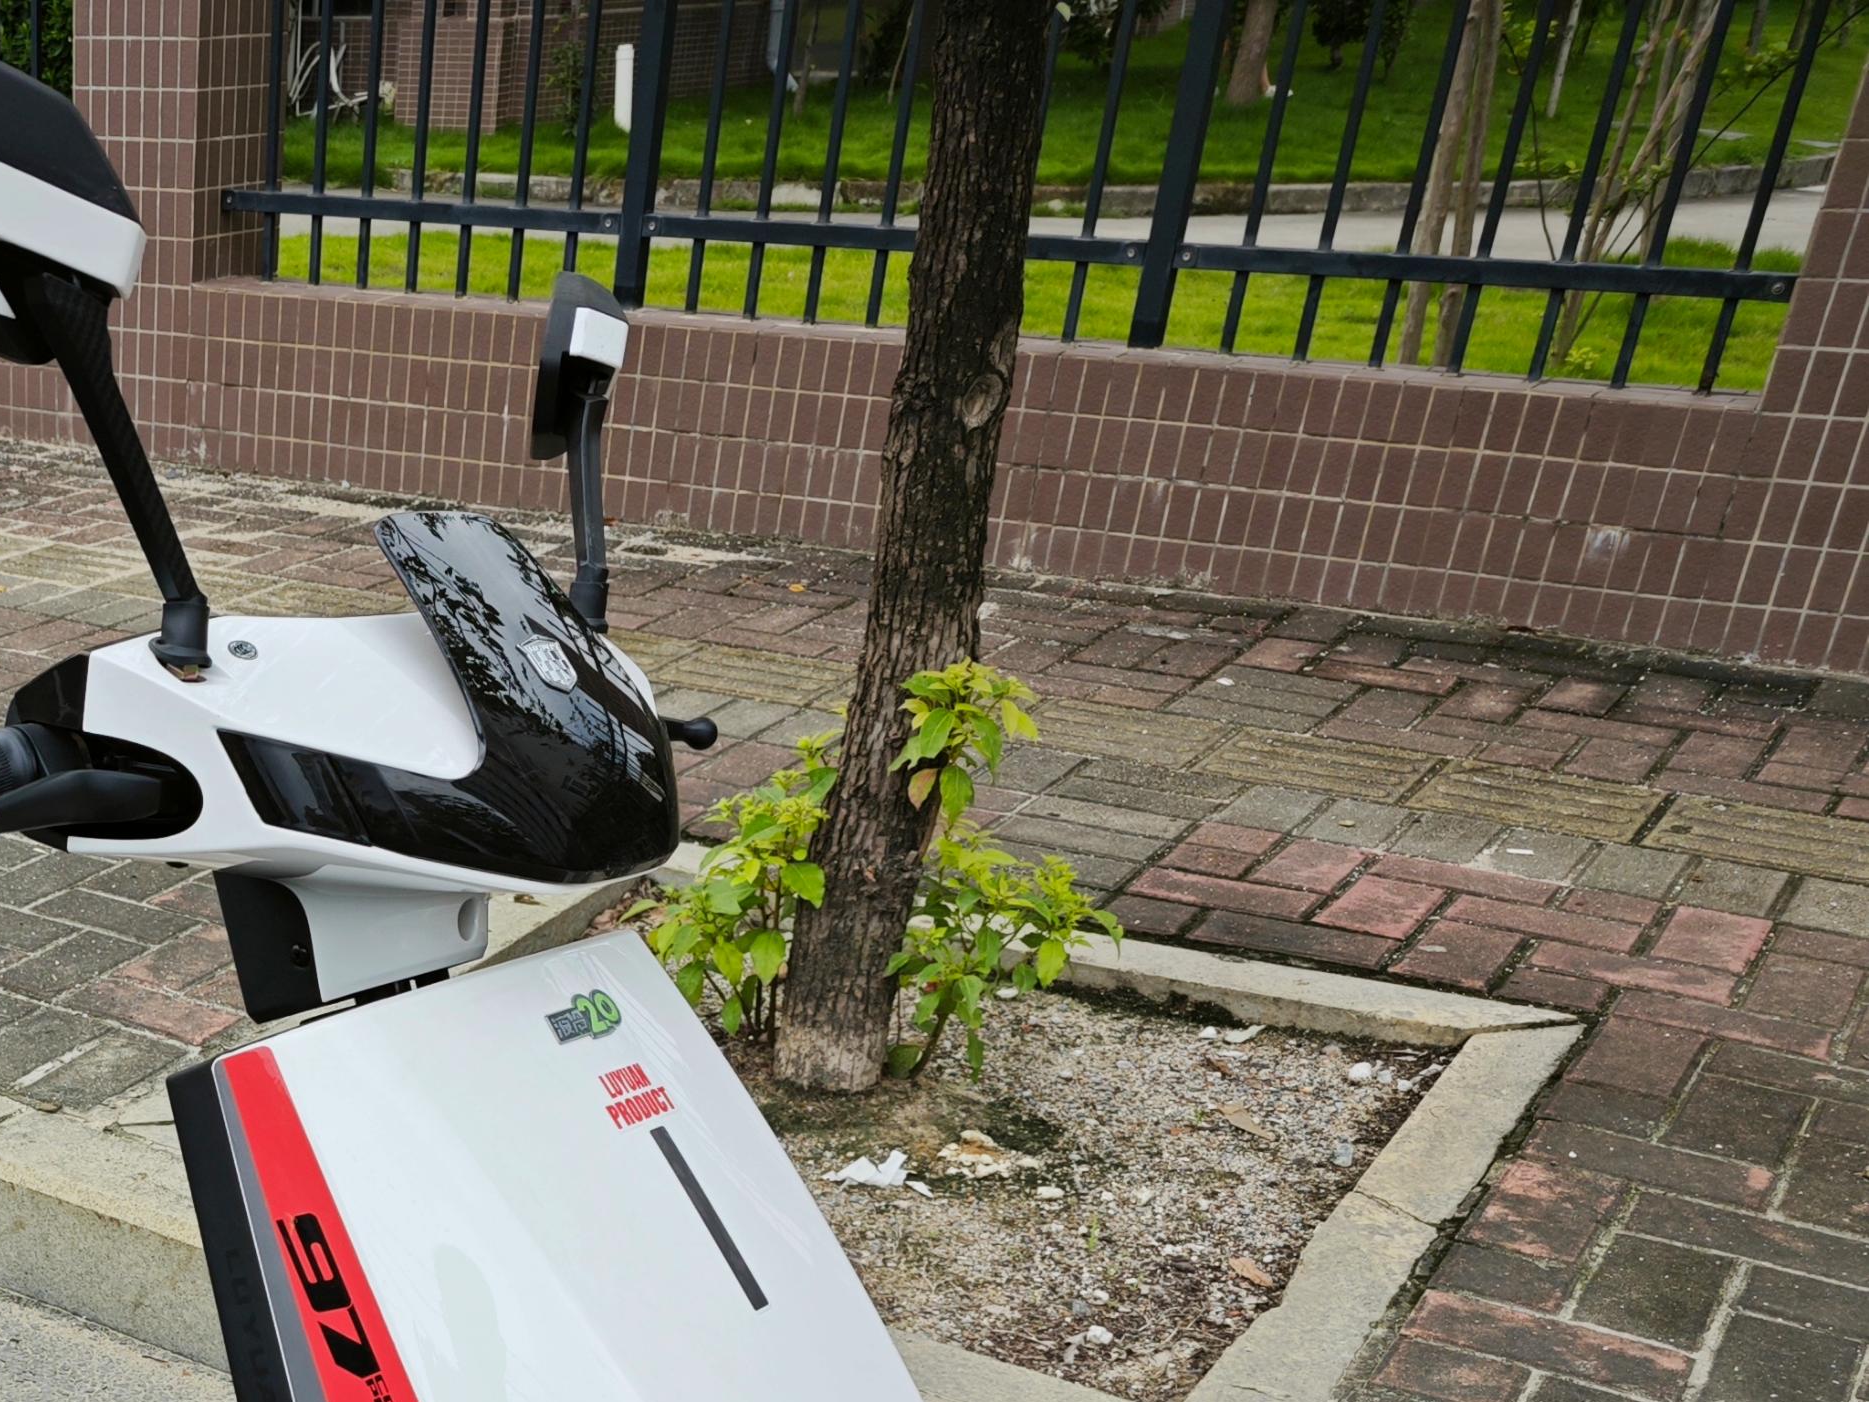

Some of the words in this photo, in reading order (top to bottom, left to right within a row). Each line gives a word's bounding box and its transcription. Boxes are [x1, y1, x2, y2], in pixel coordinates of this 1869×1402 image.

[598, 1062, 652, 1099] LUYUAN
[605, 1086, 675, 1130] PRODUCT
[276, 1212, 381, 1379] 97
